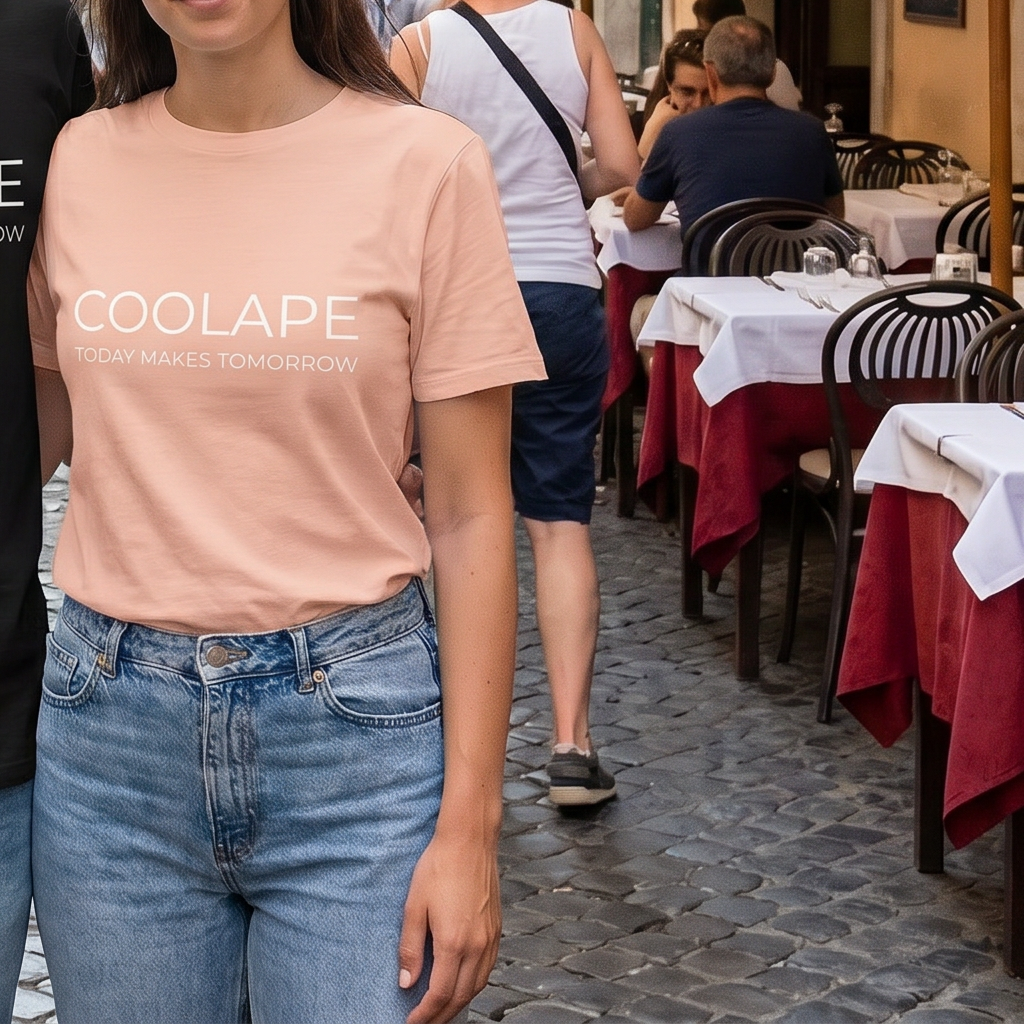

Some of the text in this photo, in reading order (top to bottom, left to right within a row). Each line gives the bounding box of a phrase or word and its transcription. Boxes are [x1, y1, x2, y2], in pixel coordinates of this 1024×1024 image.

[74, 289, 359, 340] COOLAPE
[75, 346, 359, 373] TODAY MAKES TOMORROW
